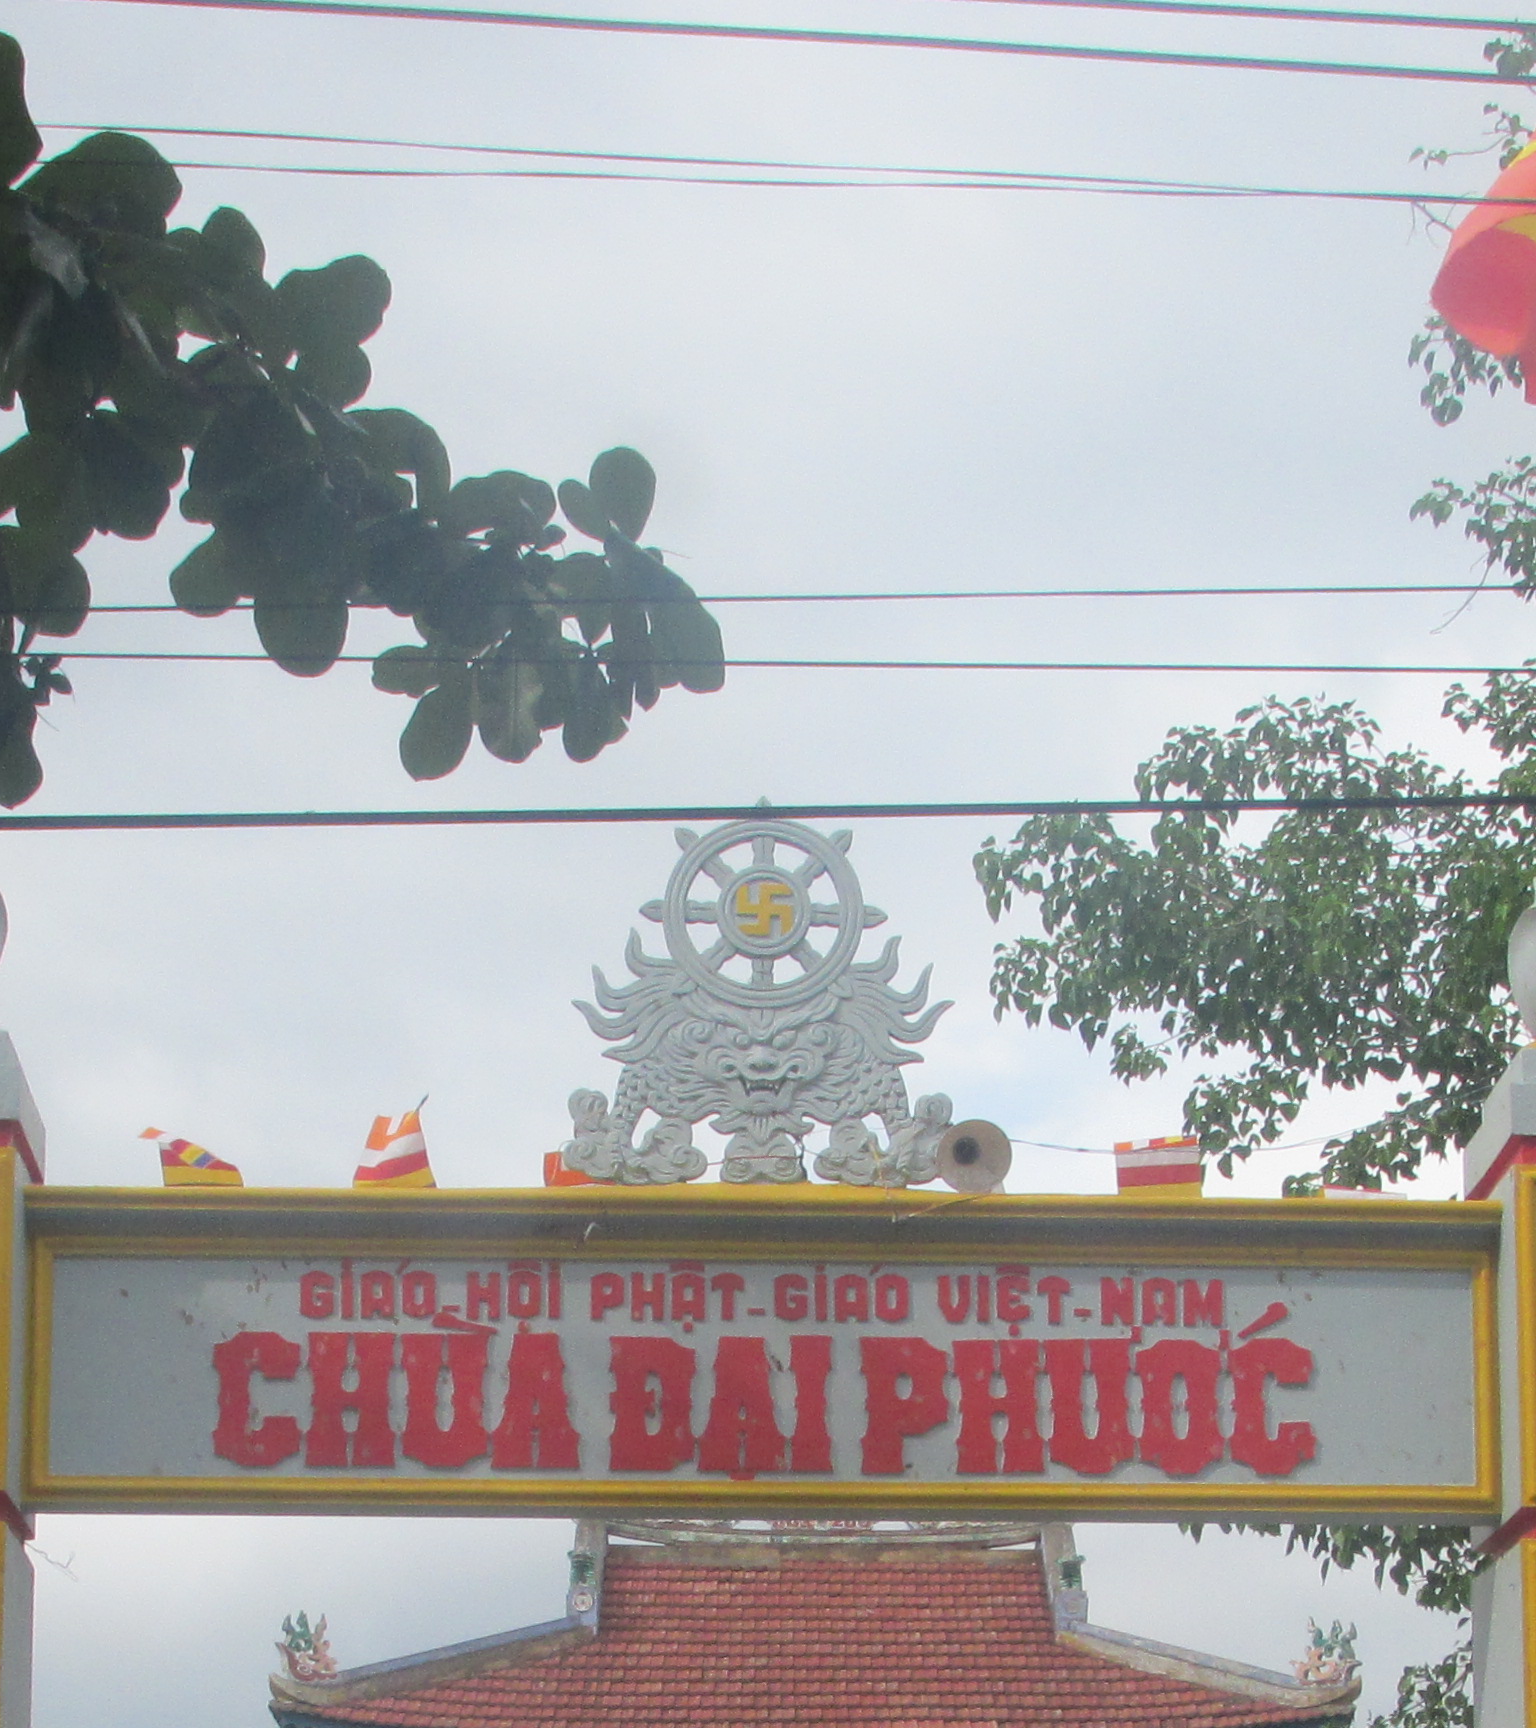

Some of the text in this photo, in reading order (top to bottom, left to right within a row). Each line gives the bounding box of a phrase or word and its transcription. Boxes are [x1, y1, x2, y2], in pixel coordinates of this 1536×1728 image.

[212, 1302, 1318, 1481] CHÙA ĐẠI PHƯỚC
